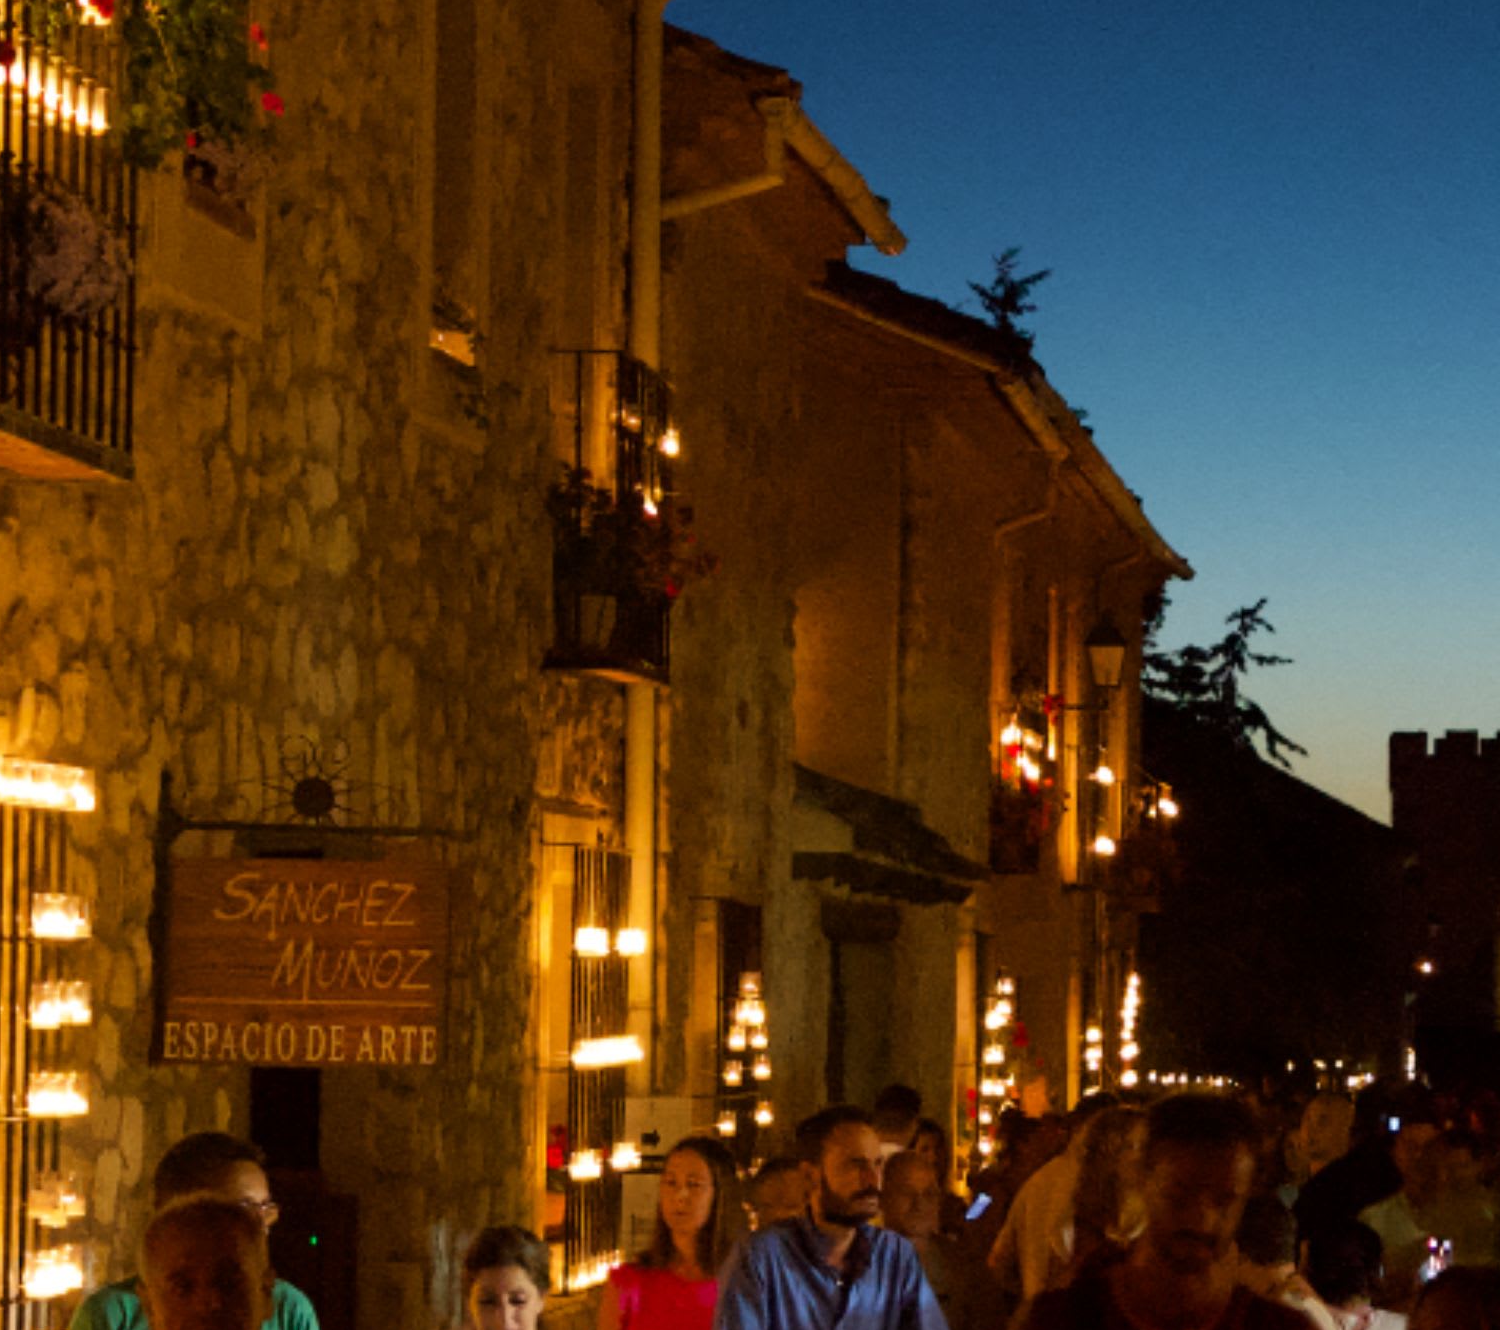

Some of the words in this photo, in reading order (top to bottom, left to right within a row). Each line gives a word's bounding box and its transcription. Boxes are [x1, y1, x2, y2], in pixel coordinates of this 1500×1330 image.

[213, 873, 416, 941] SANCHEZ
[271, 935, 432, 1004] MUÑOZ
[163, 1021, 296, 1062] ESPACIO
[306, 1024, 346, 1063] DE
[356, 1024, 437, 1066] ARTE
